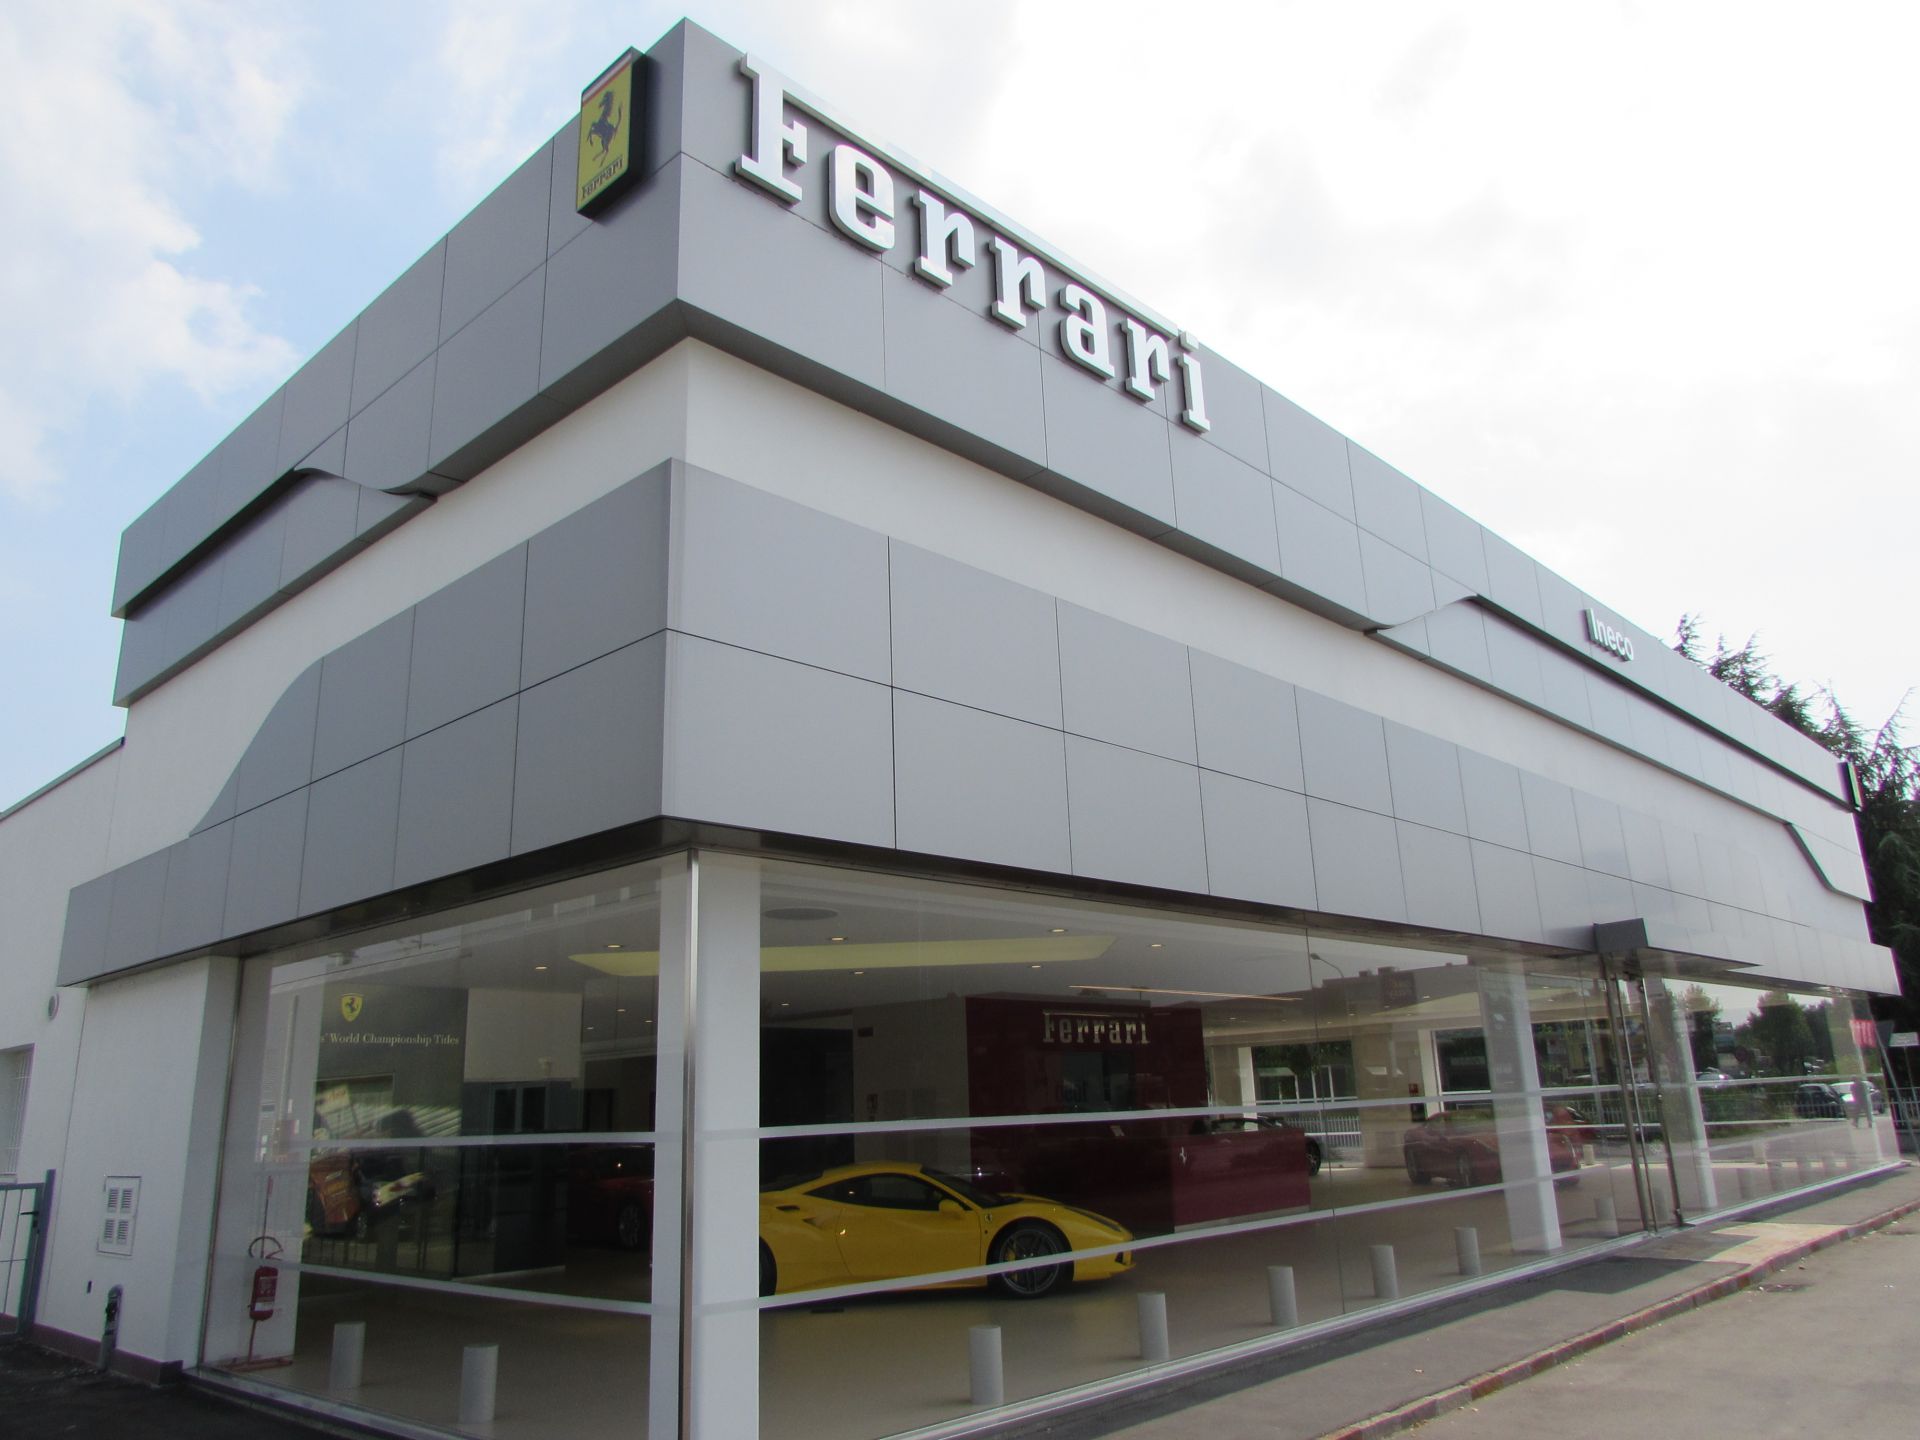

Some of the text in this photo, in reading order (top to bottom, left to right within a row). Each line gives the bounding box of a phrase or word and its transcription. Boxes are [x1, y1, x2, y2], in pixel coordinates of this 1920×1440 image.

[581, 155, 624, 199] Ferrari
[735, 52, 1210, 434] Ferrari
[1584, 607, 1634, 661] Ineco
[330, 1032, 360, 1044] World
[362, 1032, 432, 1047] Championship
[434, 1033, 460, 1045] Titles
[1042, 1010, 1151, 1044] Ferrari
